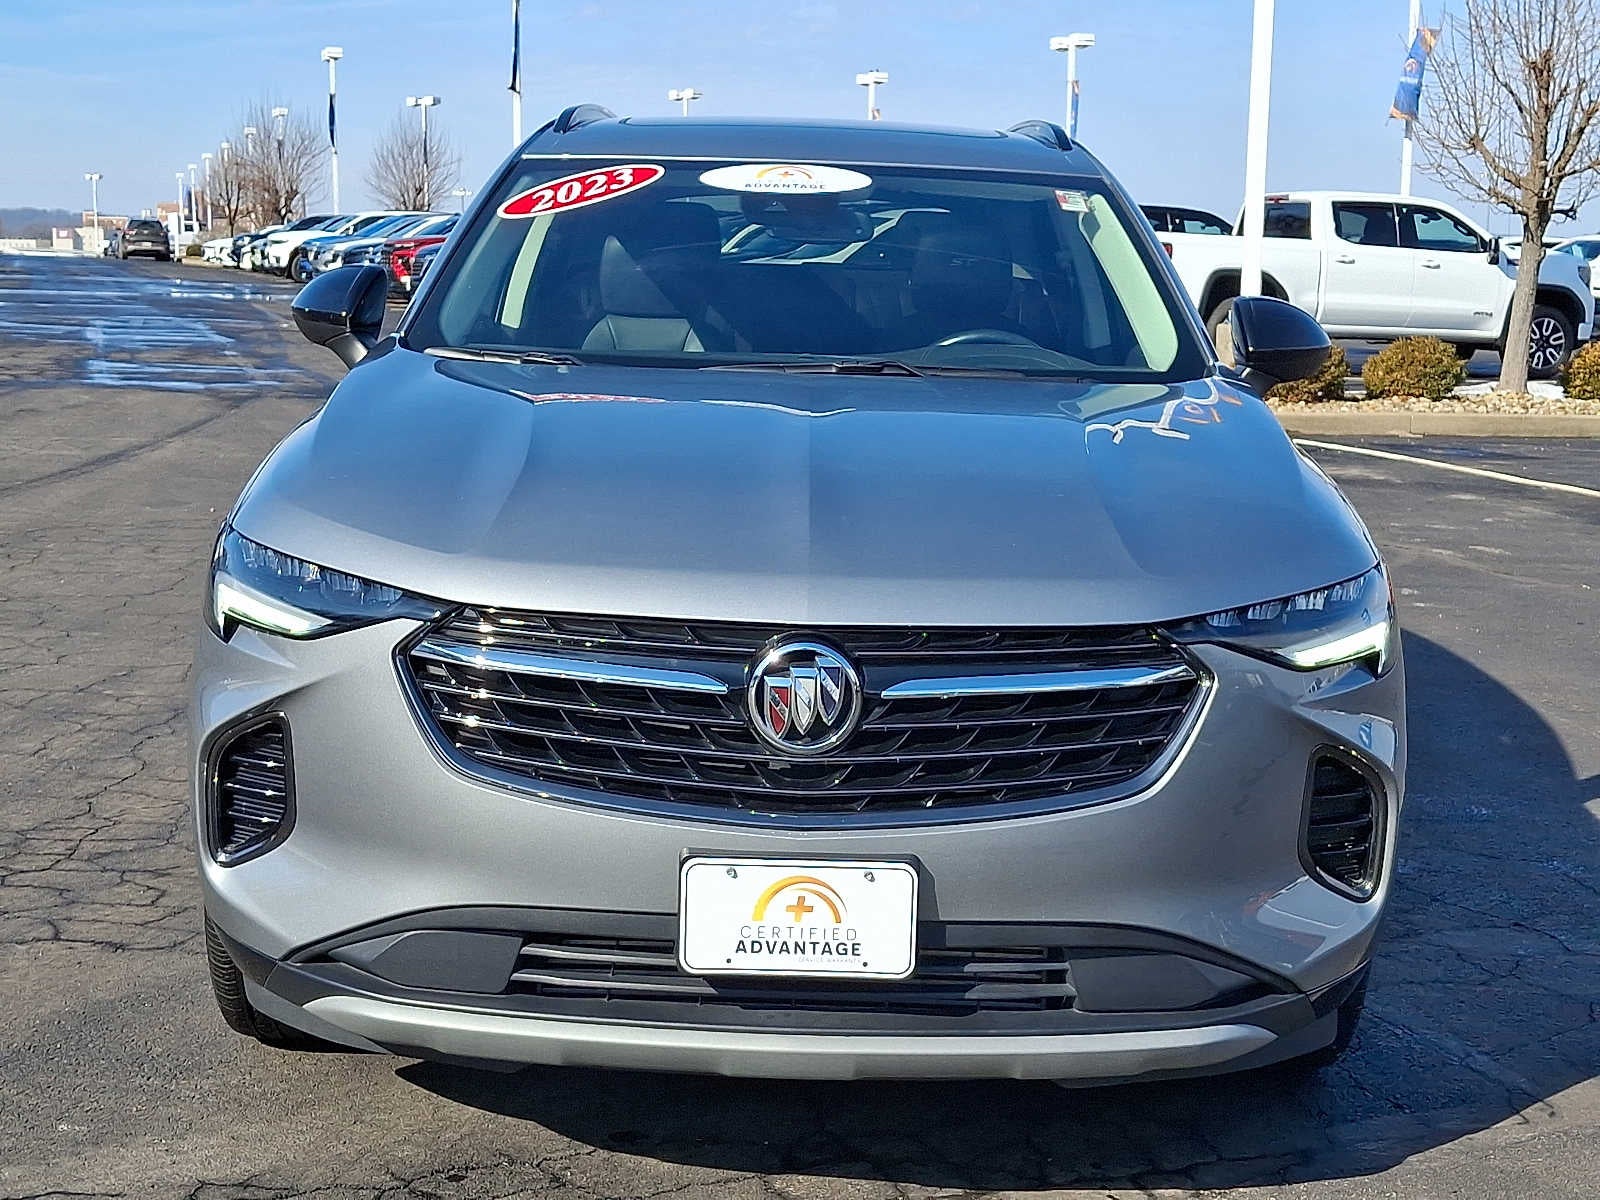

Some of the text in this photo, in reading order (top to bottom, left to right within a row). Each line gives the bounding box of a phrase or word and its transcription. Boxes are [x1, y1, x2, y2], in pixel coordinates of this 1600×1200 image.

[530, 168, 634, 213] 2023
[740, 925, 857, 941] CERTIFIED
[735, 940, 862, 957] ADVANTAGE
